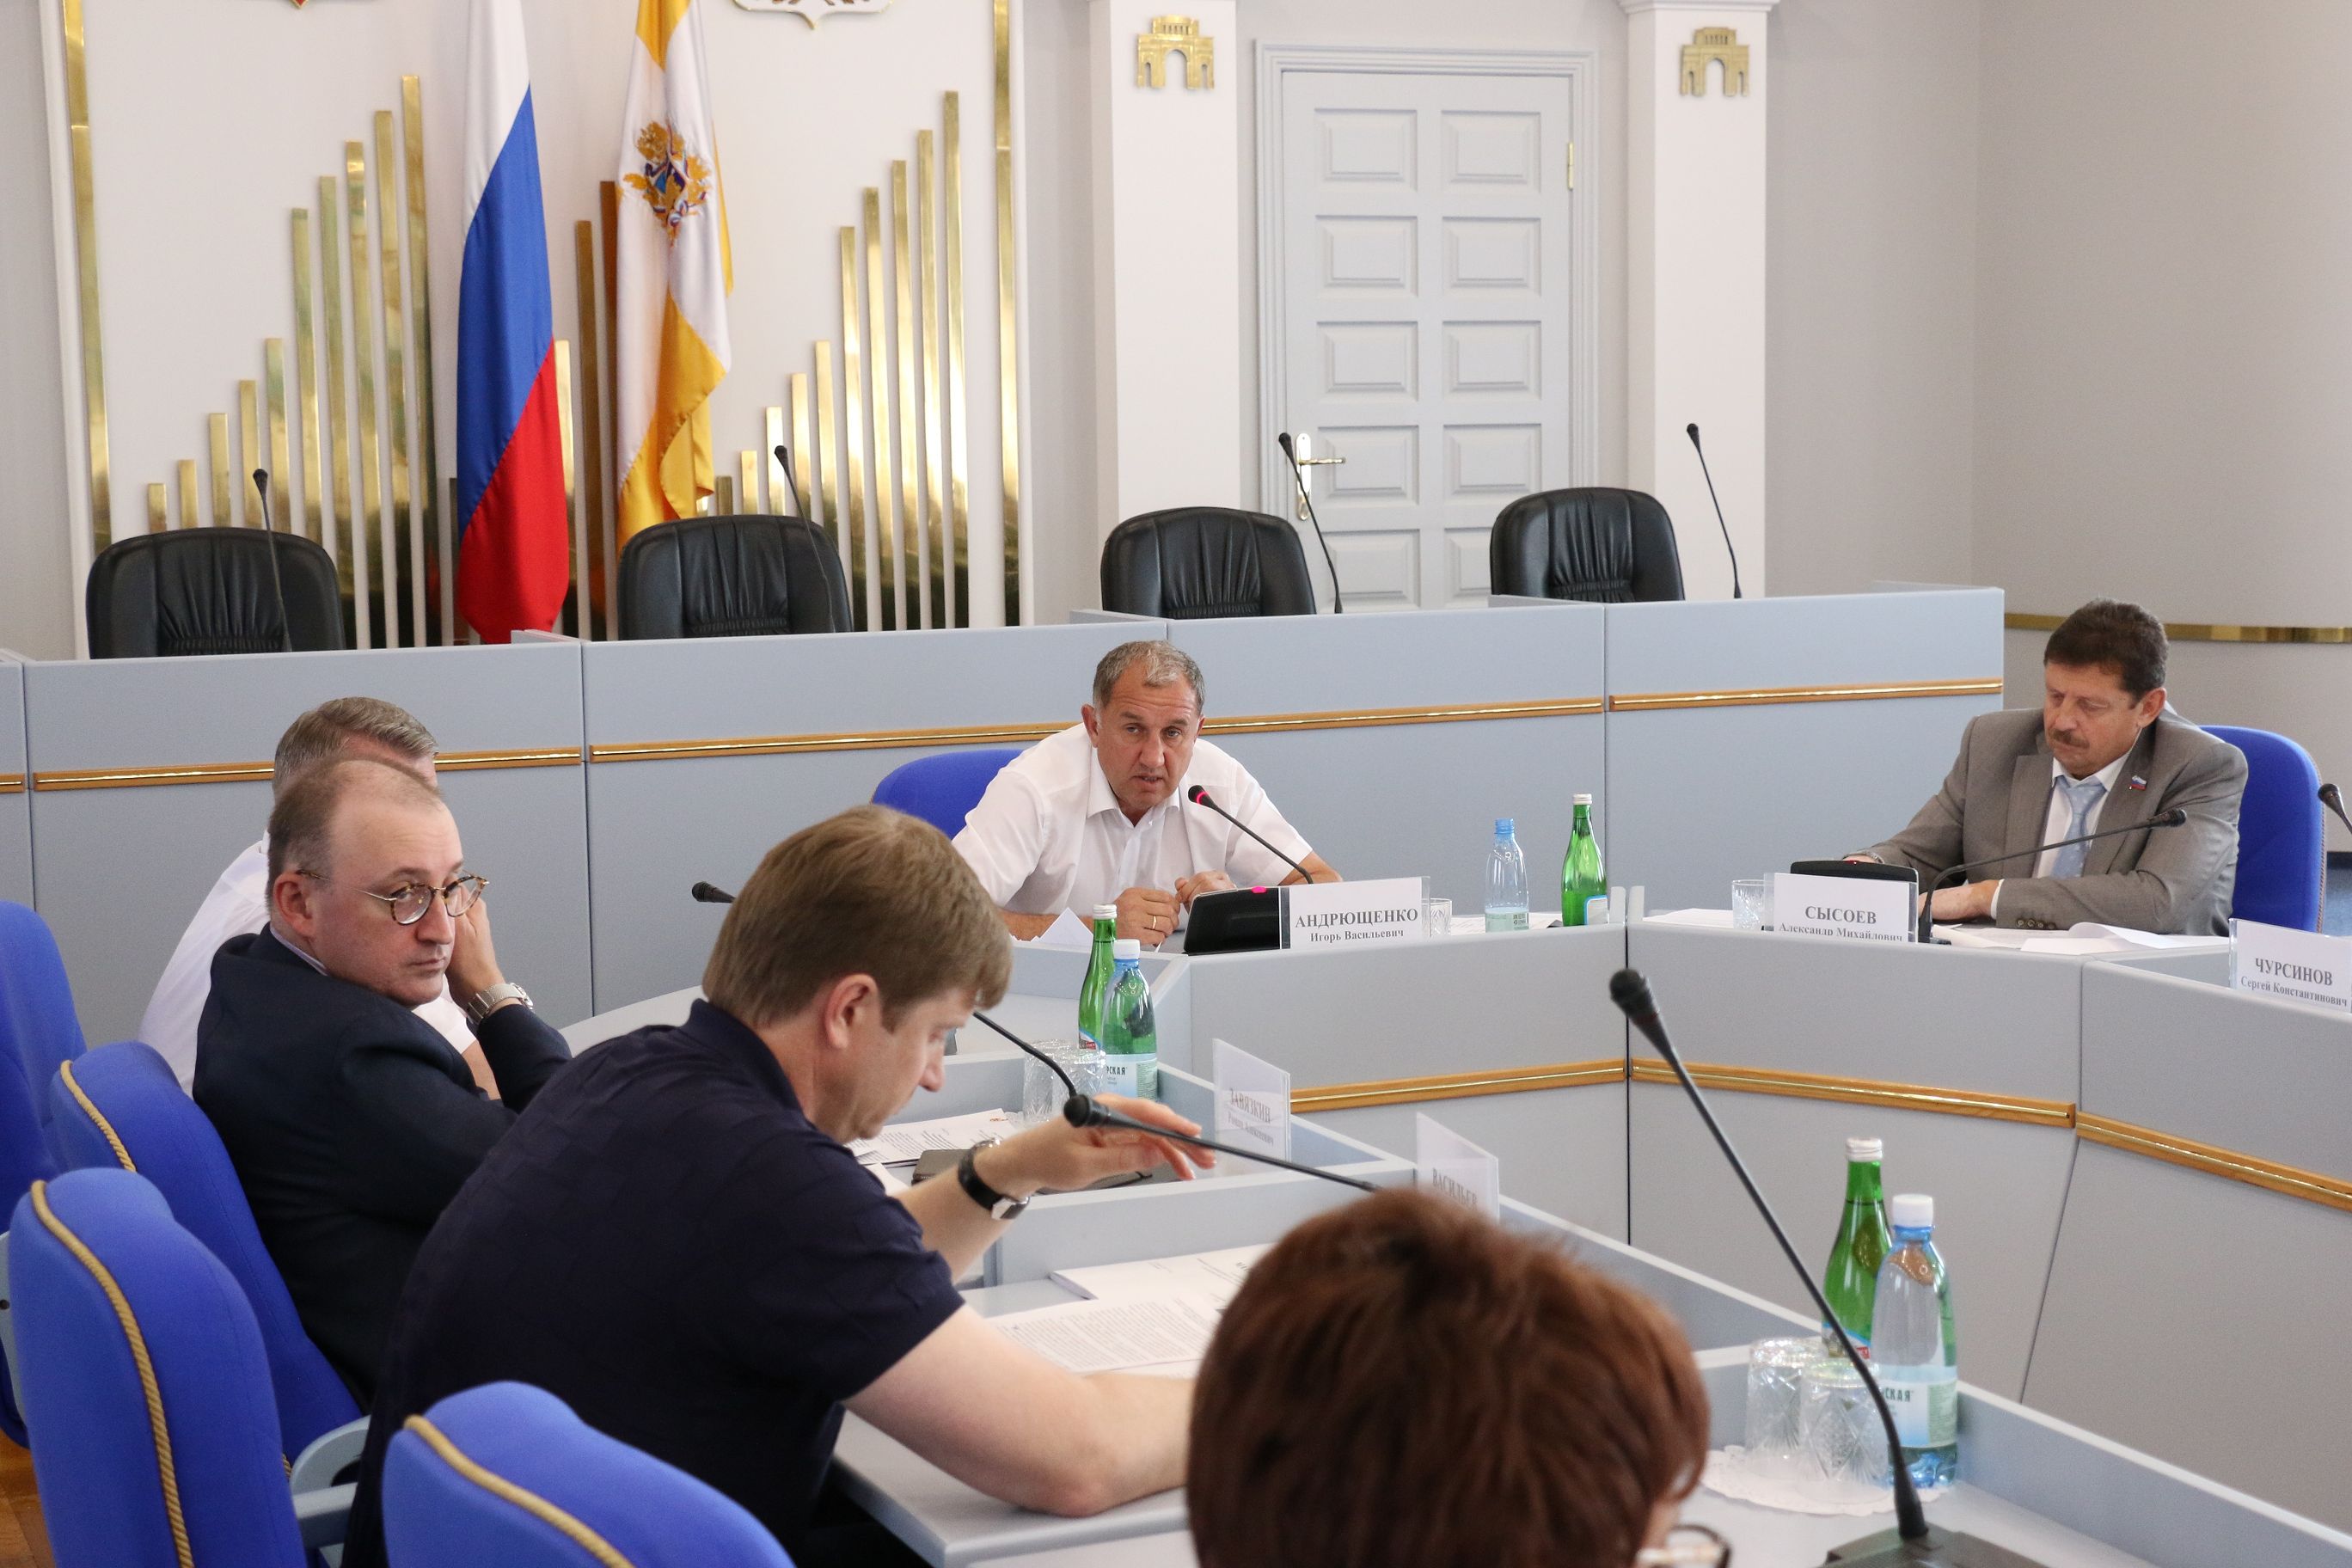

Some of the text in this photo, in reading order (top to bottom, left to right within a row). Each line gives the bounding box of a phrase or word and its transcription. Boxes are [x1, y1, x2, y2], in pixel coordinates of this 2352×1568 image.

[1295, 908, 1418, 929] АНДРЮЩЕНКО
[1805, 905, 1877, 925] СЫСОЕВ
[1310, 929, 1404, 943] Игорь Васильевич
[1779, 922, 1902, 942] Александр Михайлович
[2255, 958, 2333, 986] ЧУРСИНОВ
[2240, 976, 2348, 1008] Сергей Константинович
[1883, 1387, 1910, 1402] СКАЯ
